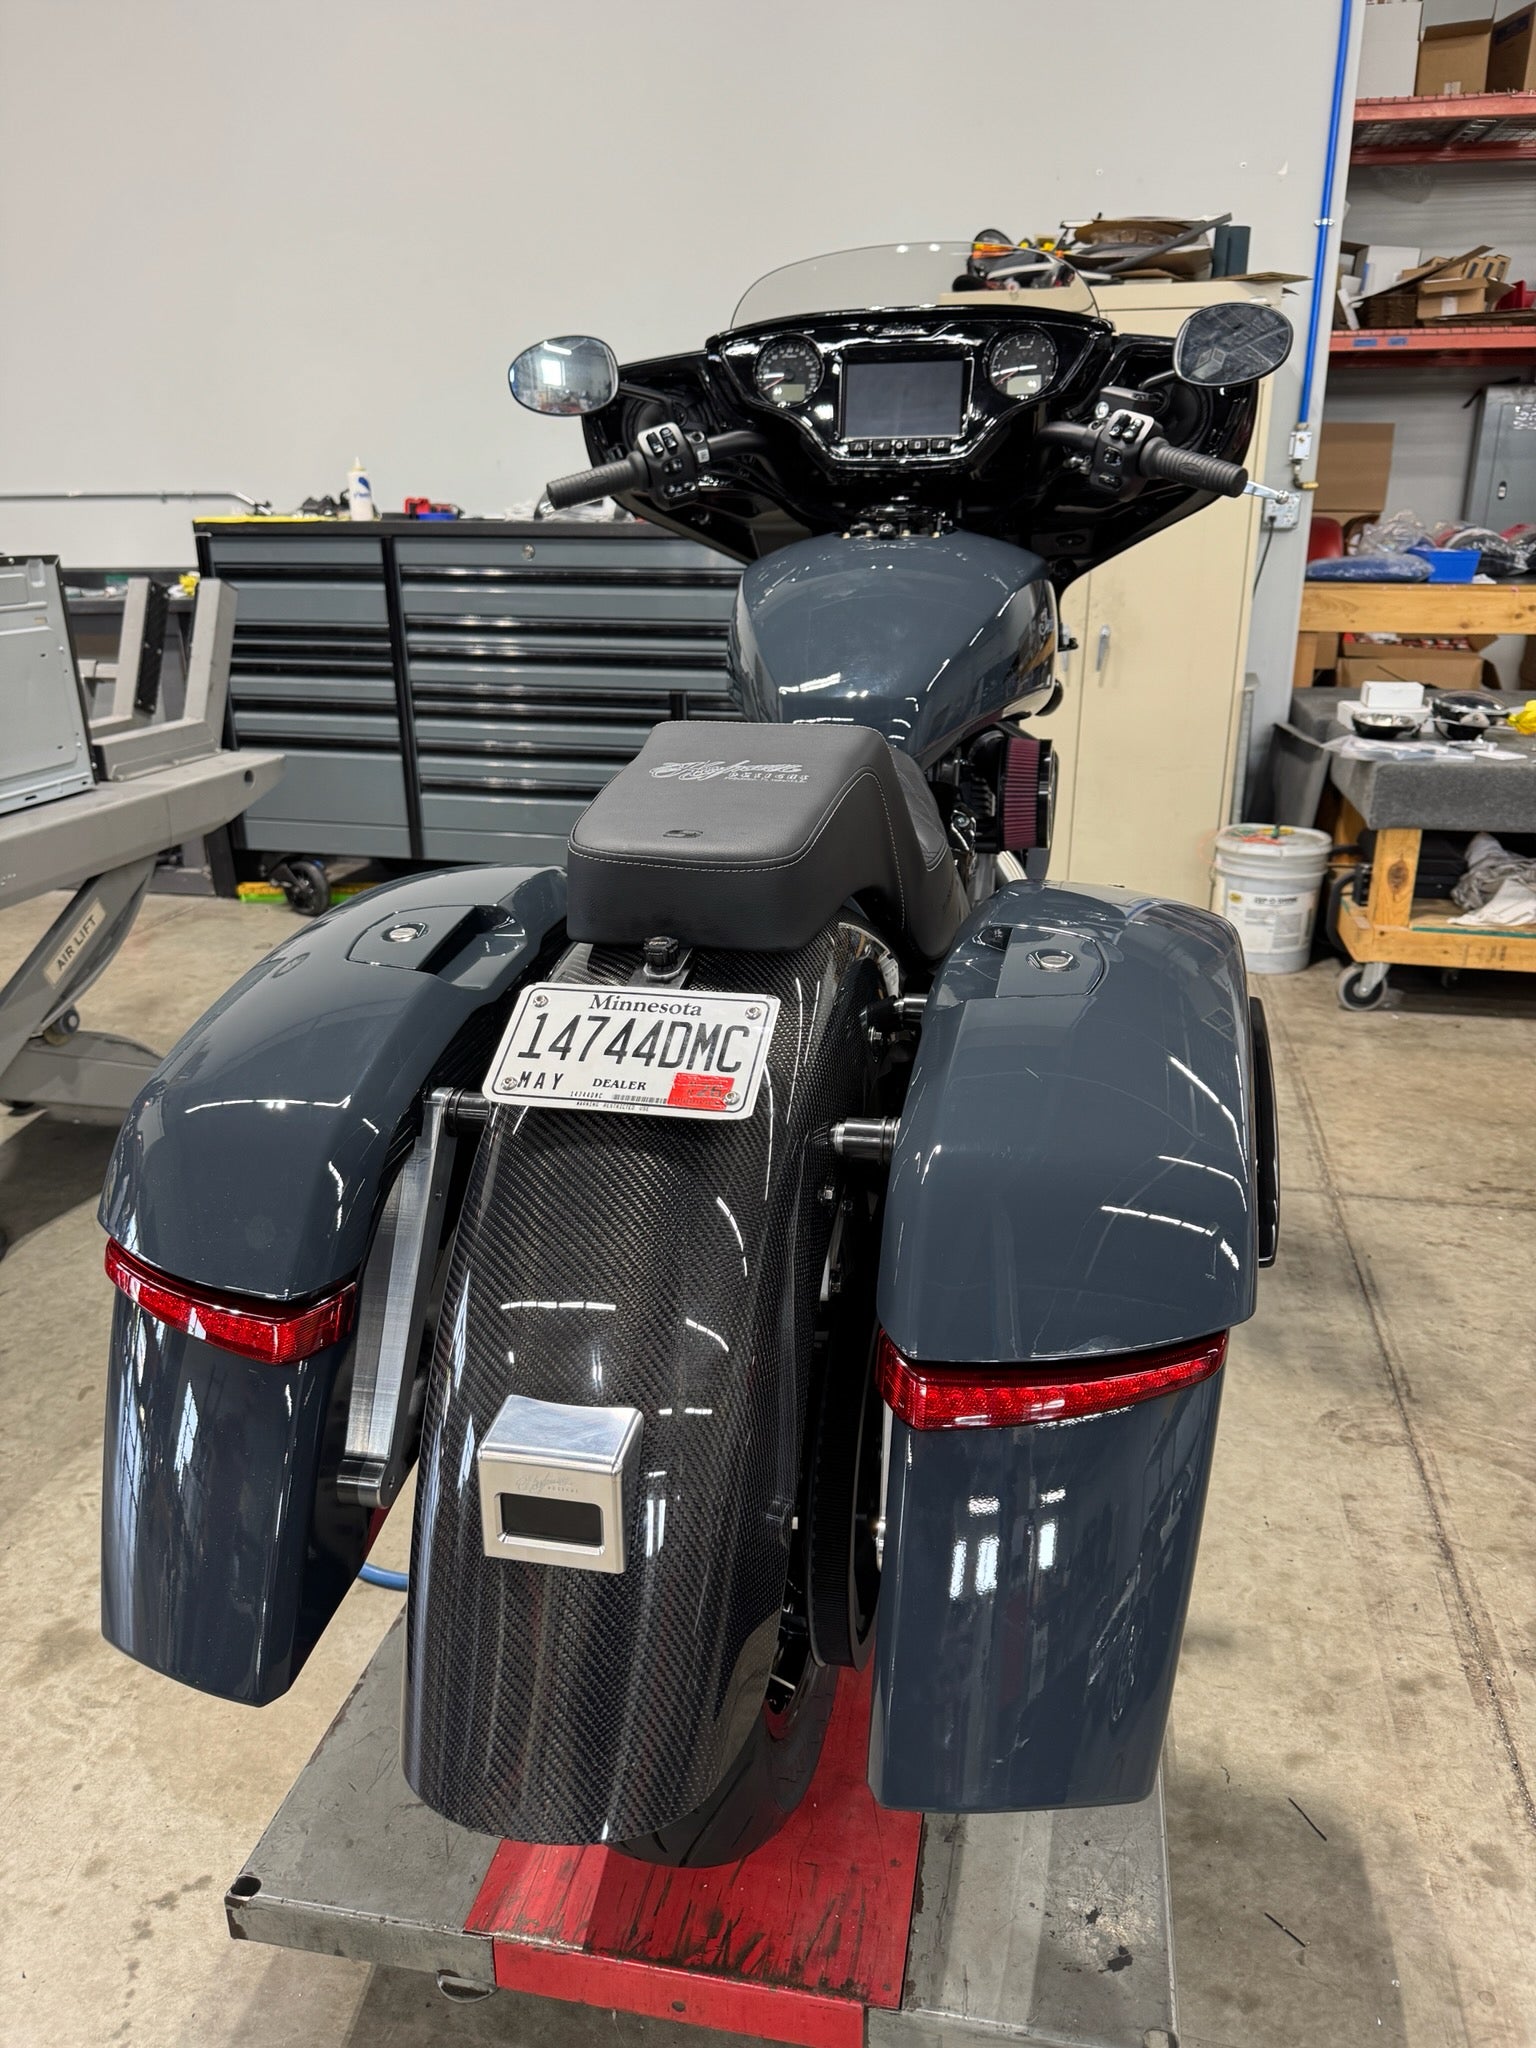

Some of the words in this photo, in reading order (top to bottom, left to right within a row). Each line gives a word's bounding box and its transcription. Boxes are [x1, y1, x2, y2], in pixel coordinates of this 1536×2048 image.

[56, 946, 75, 970] AIR
[74, 914, 97, 946] LIFT
[589, 993, 702, 1016] Minnesota
[517, 1012, 749, 1073] 14744DMC
[517, 1071, 564, 1091] MAY
[592, 1077, 648, 1092] DEALER
